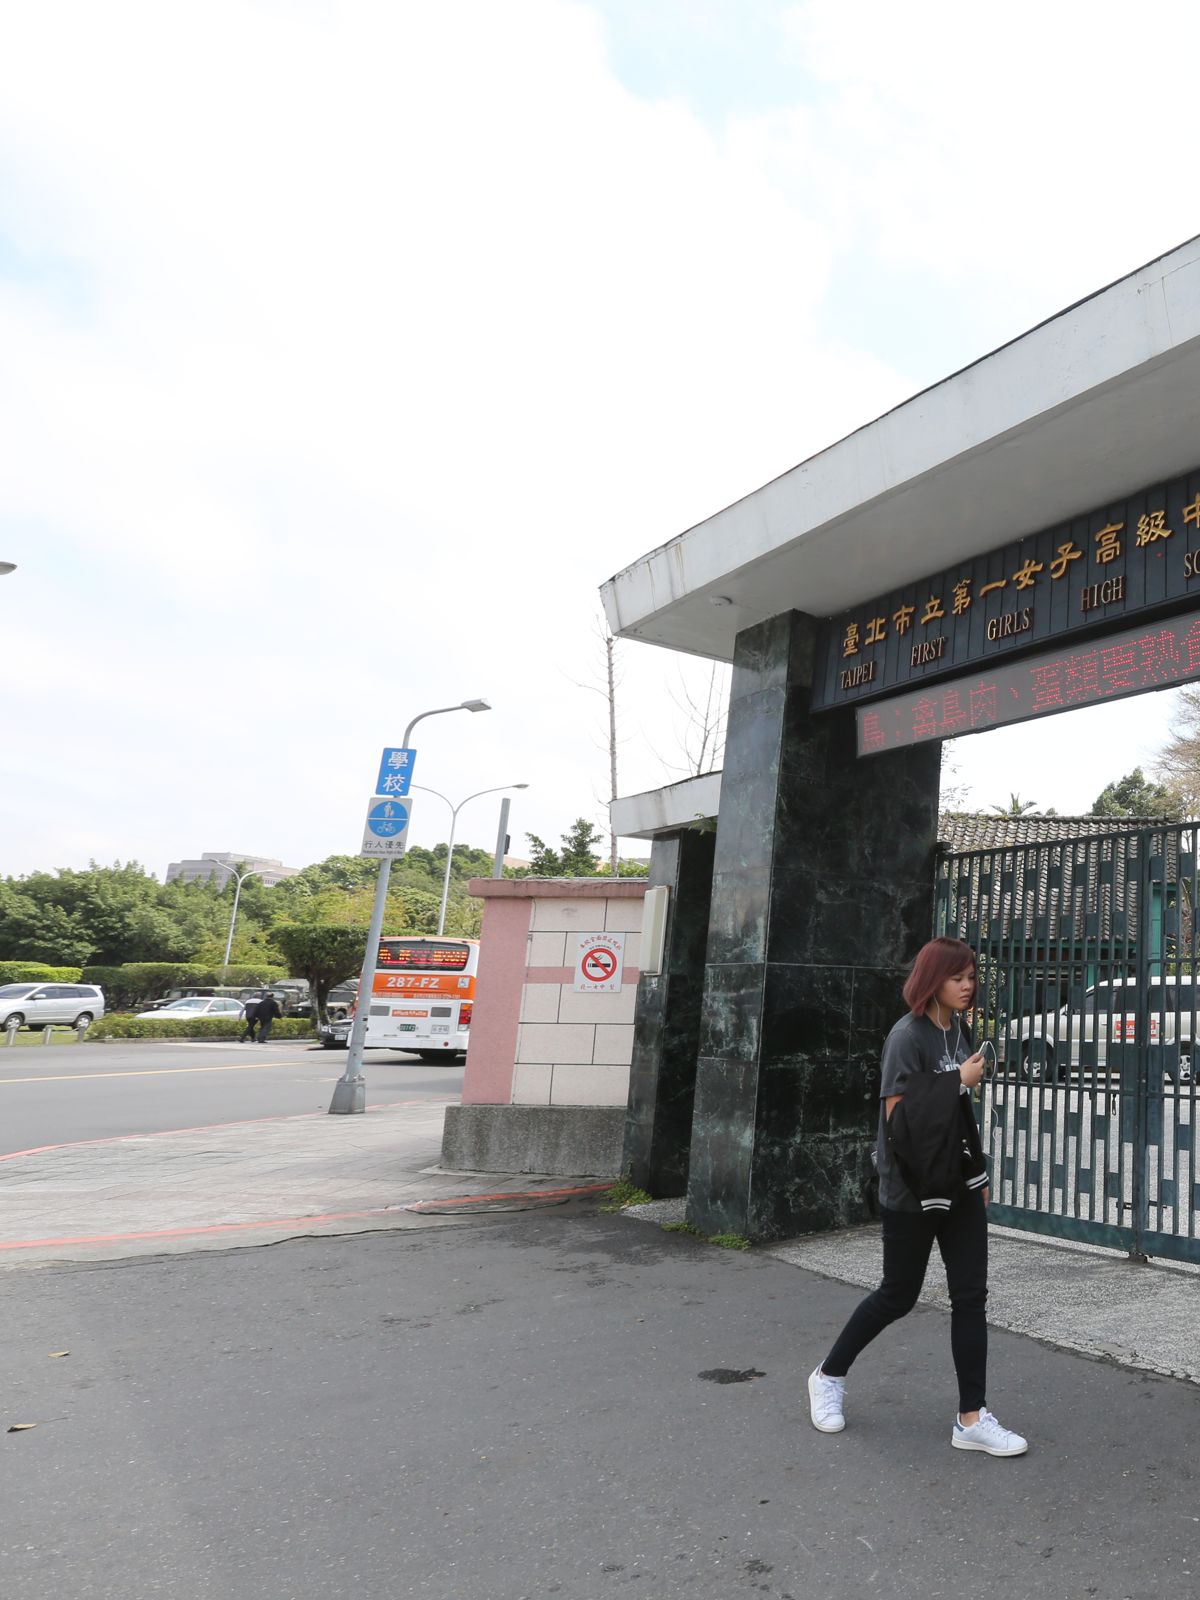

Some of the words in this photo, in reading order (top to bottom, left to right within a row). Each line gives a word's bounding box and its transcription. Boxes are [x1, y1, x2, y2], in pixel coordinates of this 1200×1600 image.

[840, 660, 874, 689] TAIPEI
[910, 636, 945, 667] FIRST
[987, 607, 1030, 641] GIRLS
[1080, 575, 1124, 611] HIGH
[382, 751, 409, 792] 學校
[386, 976, 440, 989] 287-FZ
